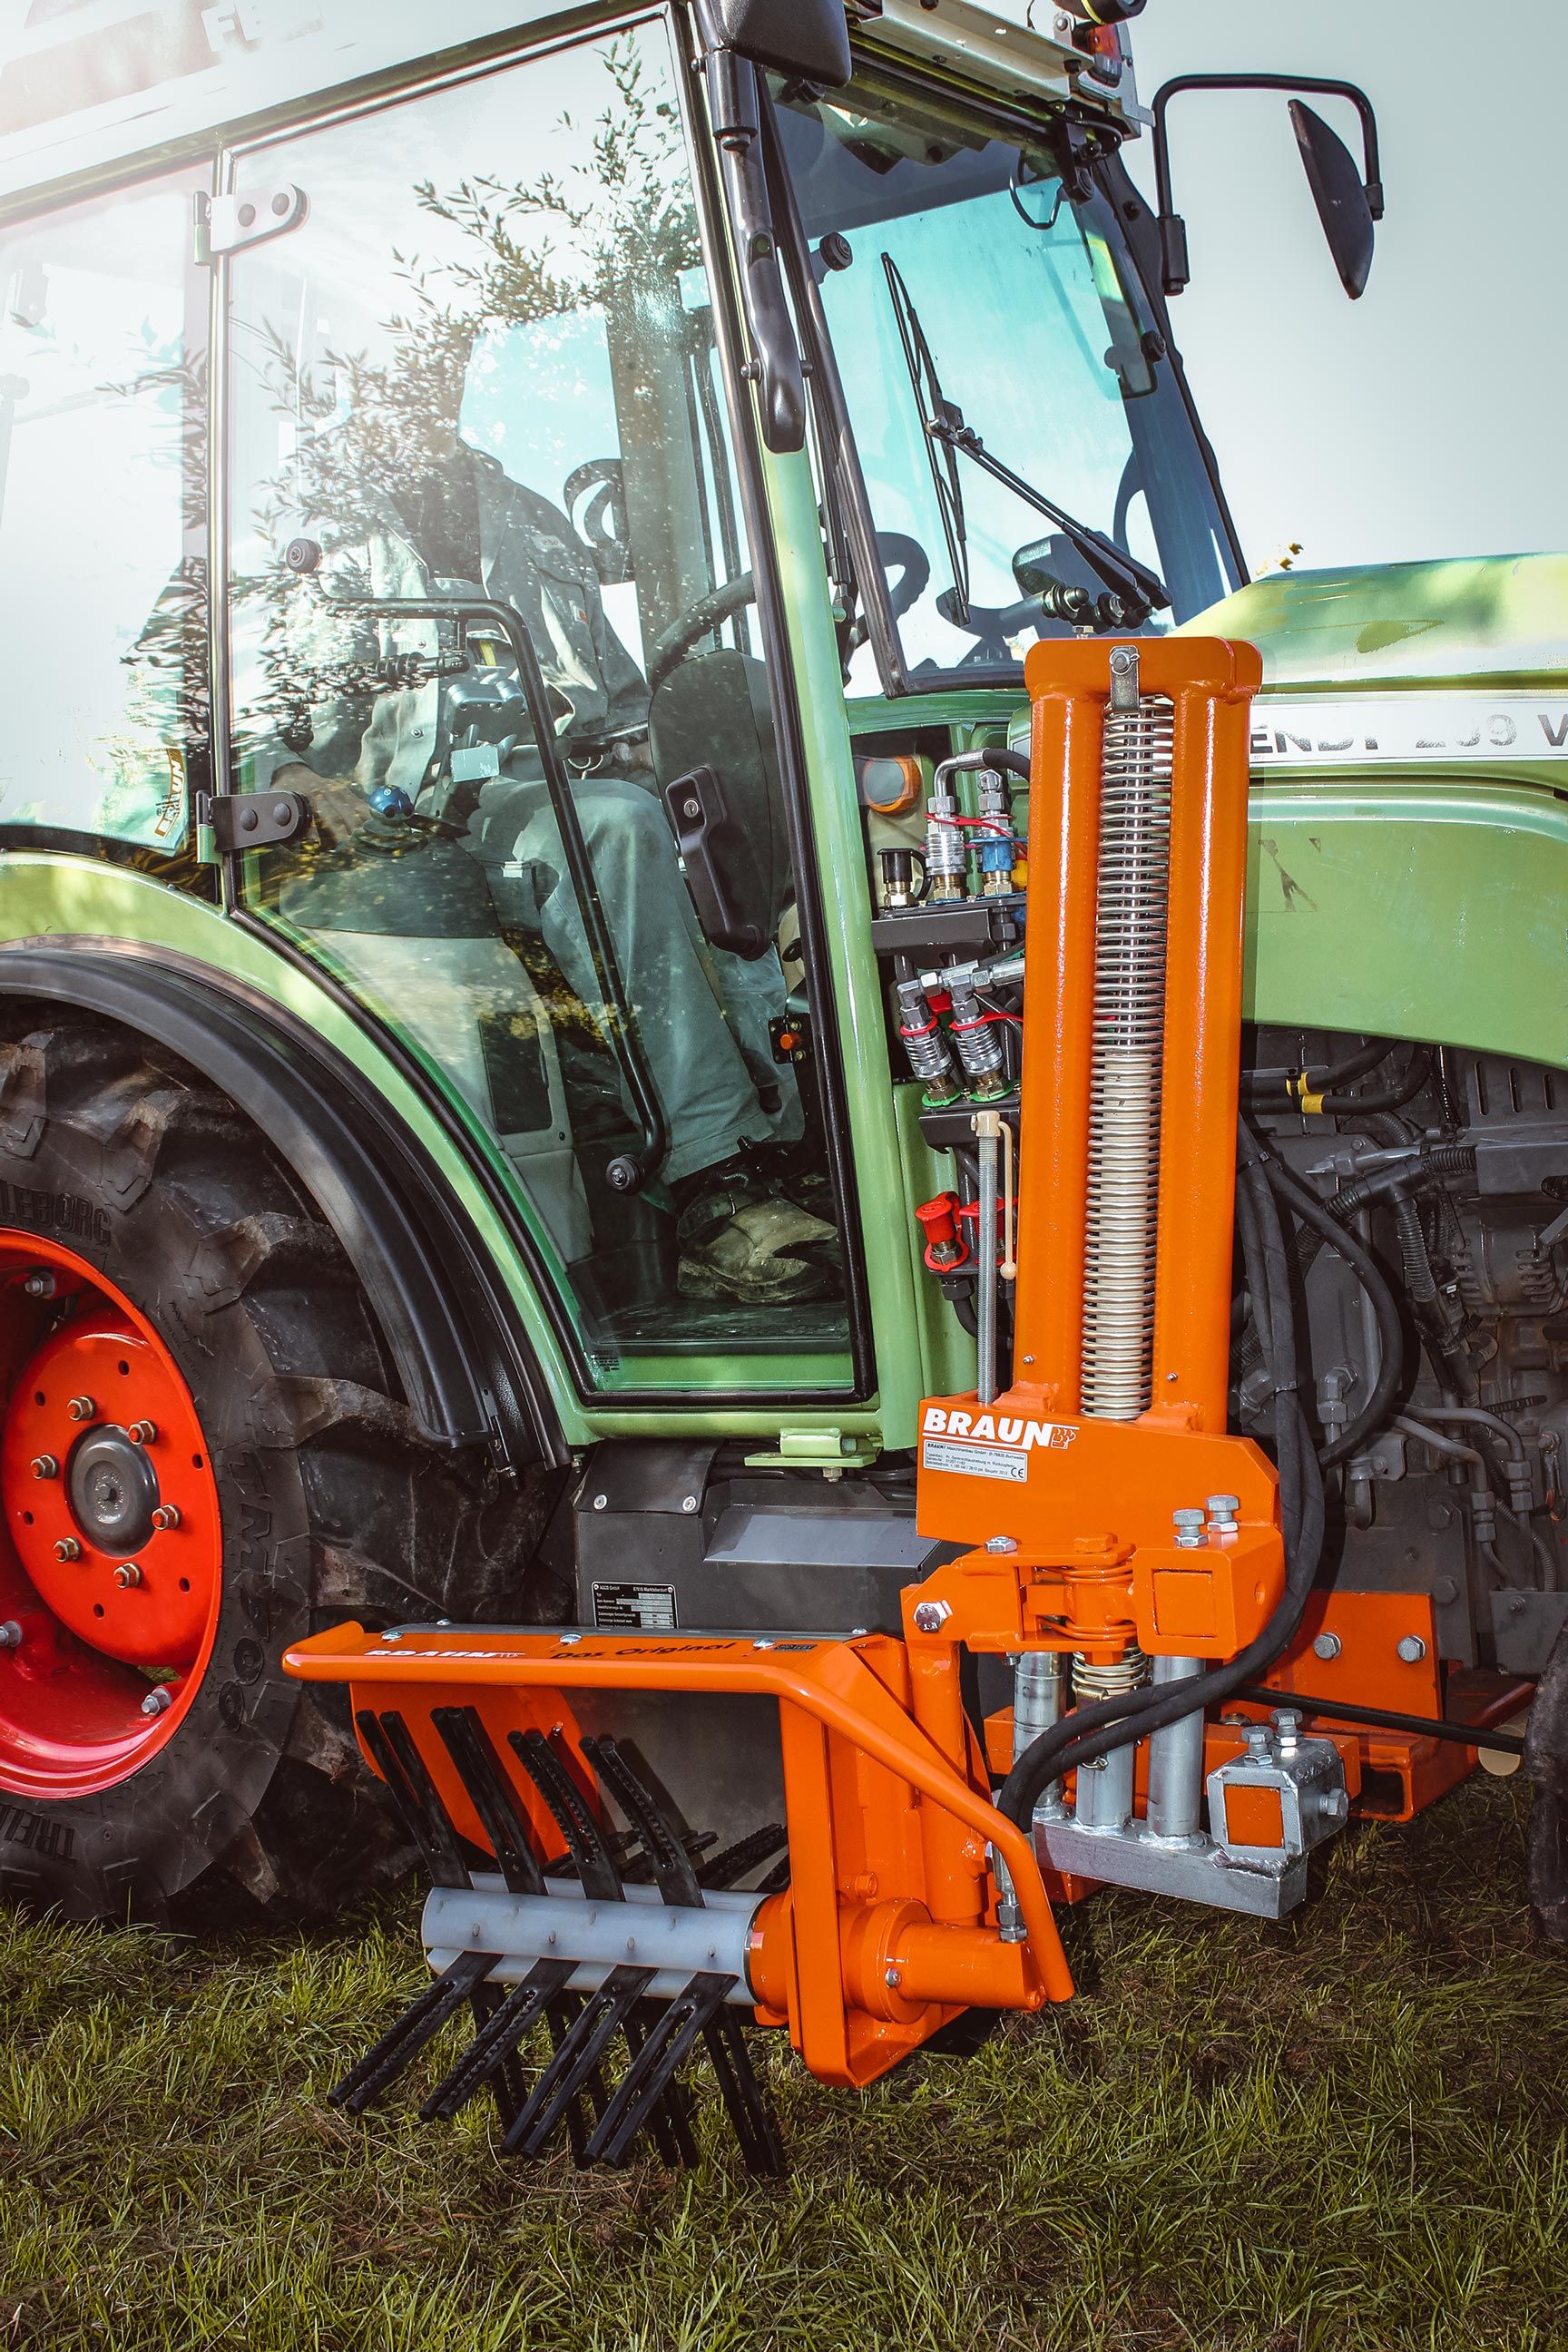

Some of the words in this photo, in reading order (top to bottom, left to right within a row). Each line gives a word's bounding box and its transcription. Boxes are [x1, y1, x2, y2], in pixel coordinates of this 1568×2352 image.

[923, 1407, 1054, 1450] BRAUN
[550, 1651, 607, 1660] Das
[615, 1642, 737, 1655] Original
